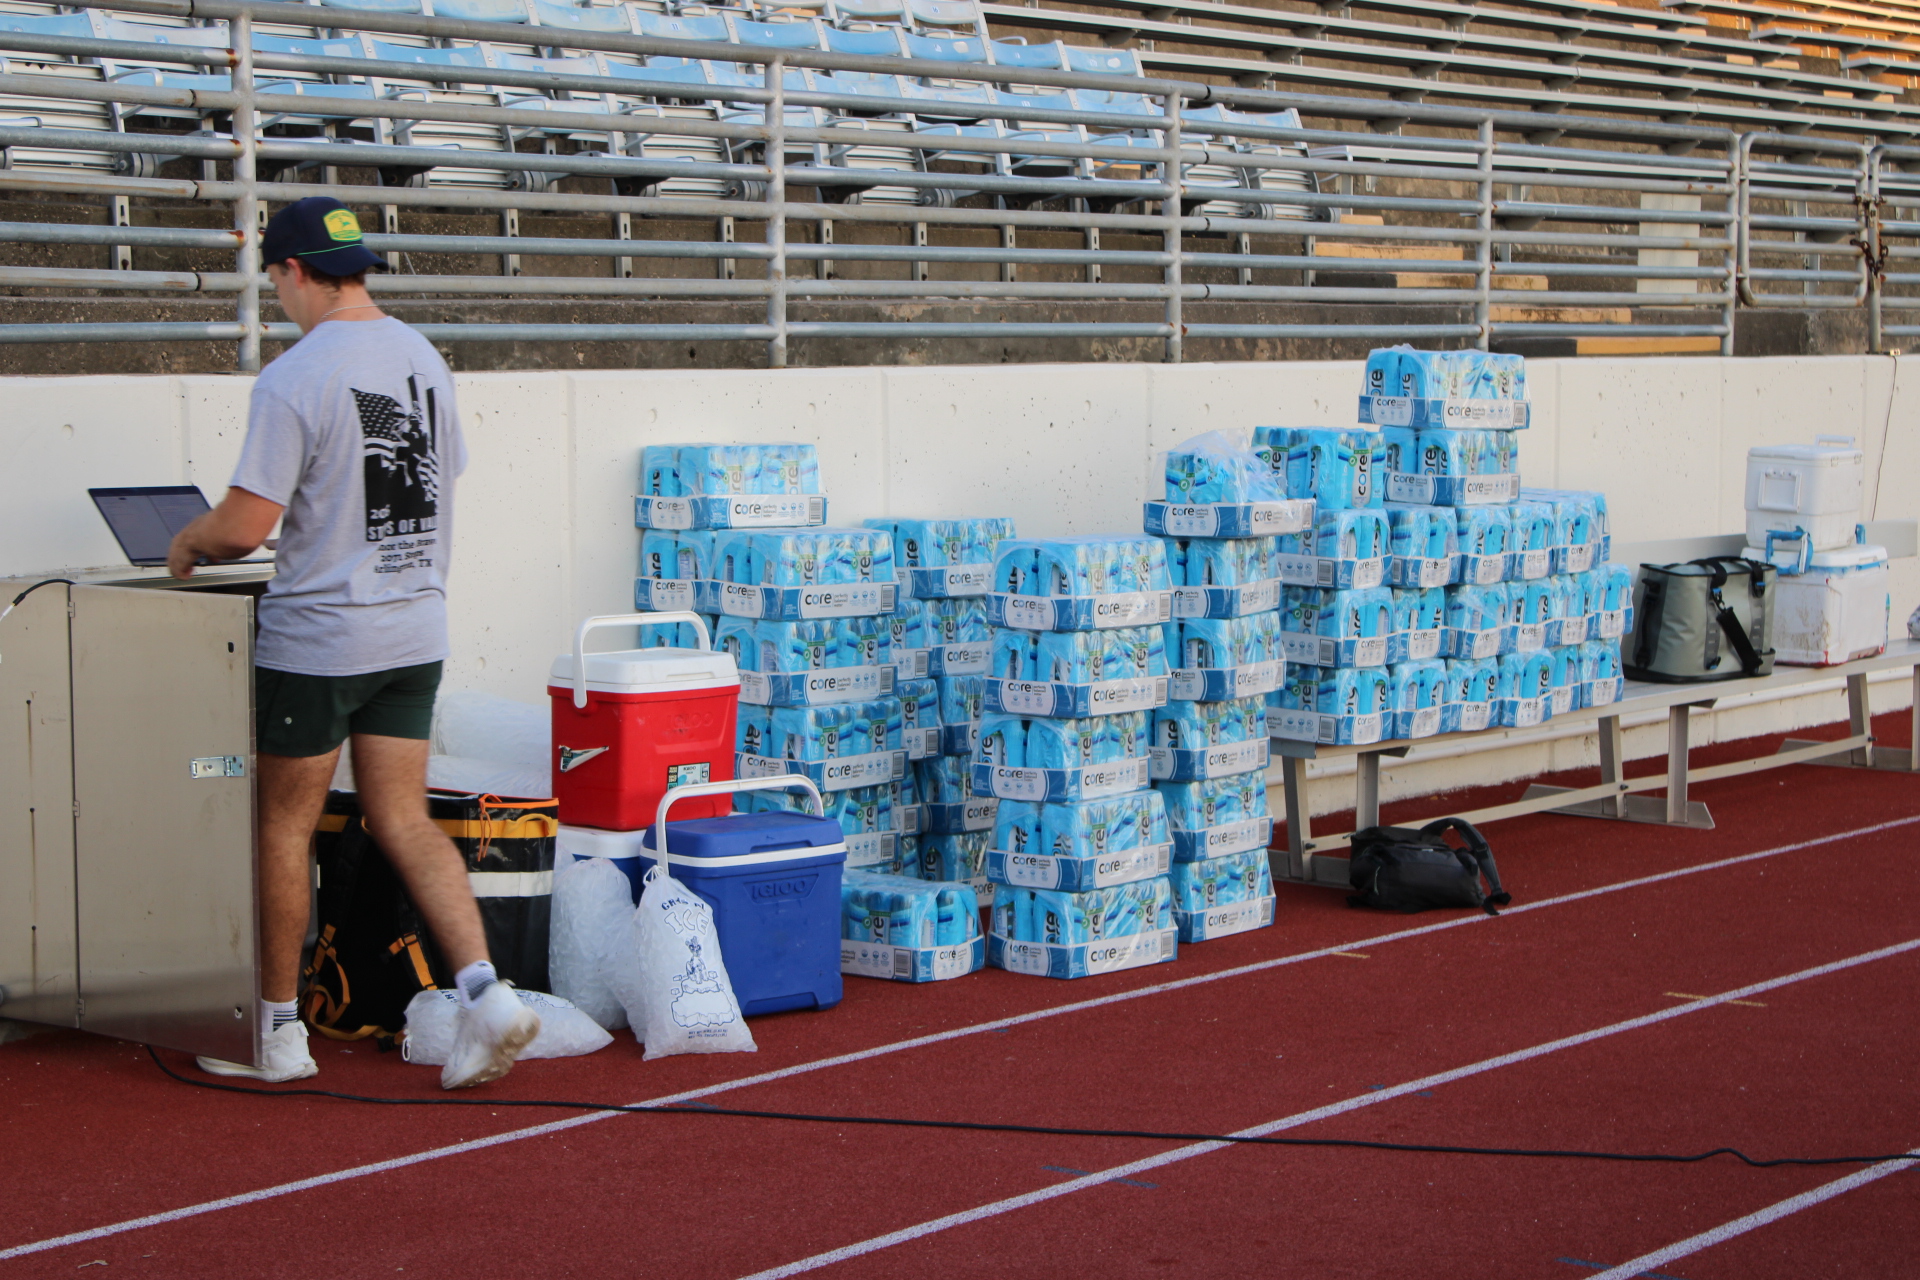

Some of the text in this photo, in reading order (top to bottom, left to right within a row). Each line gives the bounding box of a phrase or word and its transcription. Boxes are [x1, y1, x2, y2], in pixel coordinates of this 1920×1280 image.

[1371, 370, 1383, 396] ore
[1403, 374, 1411, 397] ore
[1377, 399, 1396, 407] core
[1448, 405, 1471, 416] core
[1425, 449, 1436, 475] ore
[789, 466, 799, 495] ore
[1358, 455, 1368, 495] core
[1394, 475, 1414, 483] core
[1468, 482, 1484, 493] core
[657, 501, 678, 511] core
[735, 503, 761, 515] core
[1172, 507, 1195, 516] core
[1255, 510, 1273, 522] core
[398, 519, 417, 533] OF
[1302, 531, 1312, 556] ore
[907, 540, 918, 567] ore
[652, 553, 661, 579] ore
[804, 559, 814, 586] ore
[860, 556, 871, 583] ore
[1358, 561, 1370, 570] ore
[949, 573, 971, 584] core
[656, 582, 676, 590] core
[727, 585, 747, 596] core
[805, 593, 832, 605] core
[1012, 600, 1036, 609] core
[1098, 602, 1120, 615] core
[1303, 609, 1312, 635] ore
[893, 624, 902, 649] ore
[1414, 632, 1427, 641] core
[1361, 640, 1375, 648] core
[867, 641, 875, 665] ore
[948, 650, 969, 661] core
[1137, 649, 1146, 678] ore
[739, 674, 751, 682] ore
[1171, 671, 1181, 679] re
[810, 678, 836, 690] core
[1008, 682, 1032, 693] core
[1094, 690, 1116, 702] core
[1303, 684, 1312, 711] ore
[905, 702, 915, 729] ore
[875, 725, 884, 752] ore
[1168, 720, 1178, 748] ore
[827, 732, 836, 759] ore
[982, 736, 993, 763] ore
[1083, 738, 1092, 766] ore
[1209, 753, 1228, 766] core
[828, 765, 851, 778] core
[999, 769, 1023, 779] core
[1085, 772, 1105, 786] core
[1243, 791, 1251, 819] ore
[866, 806, 875, 832] ore
[968, 807, 989, 818] core
[1142, 816, 1150, 846] ore
[1097, 829, 1105, 856] ore
[1210, 832, 1228, 845] core
[925, 853, 936, 881] ore
[1013, 856, 1037, 866] core
[1099, 859, 1120, 874] core
[751, 880, 806, 900] IGLOO
[1247, 871, 1255, 900] ore
[664, 909, 709, 935] ICE
[1208, 913, 1228, 926] core
[874, 916, 884, 944] ore
[1046, 912, 1055, 943] ore
[940, 950, 956, 959] core
[1091, 948, 1117, 962] core
